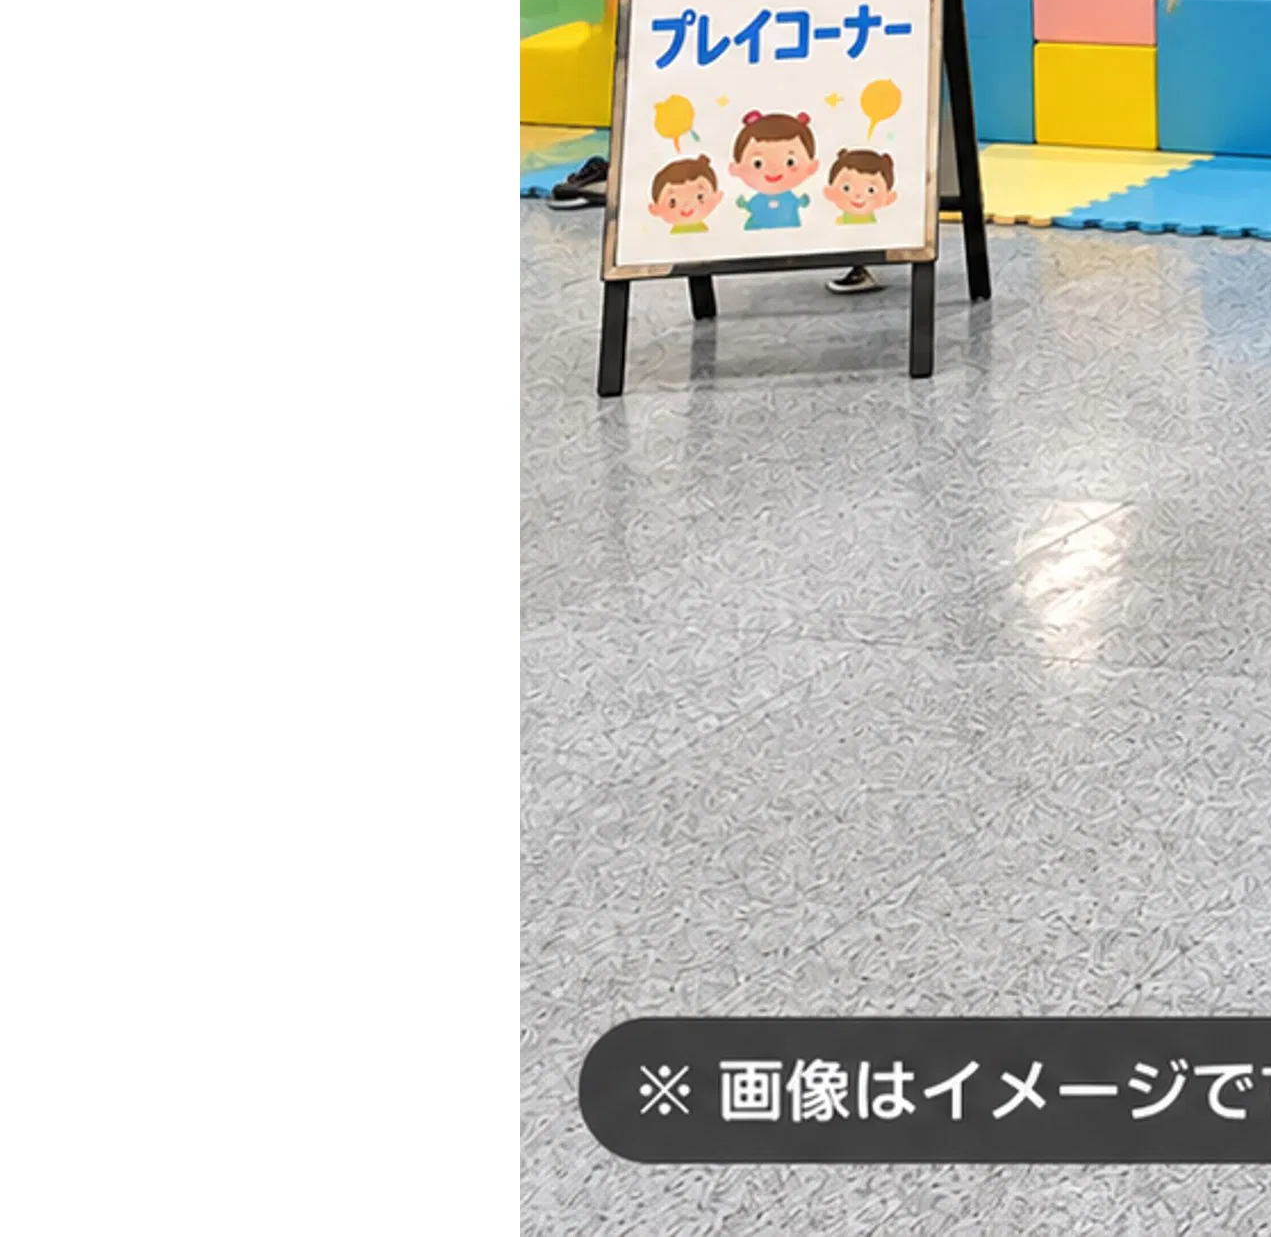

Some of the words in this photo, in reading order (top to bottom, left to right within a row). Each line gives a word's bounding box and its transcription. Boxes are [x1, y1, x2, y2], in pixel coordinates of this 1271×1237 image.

[651, 4, 913, 69] プレイコーナー
